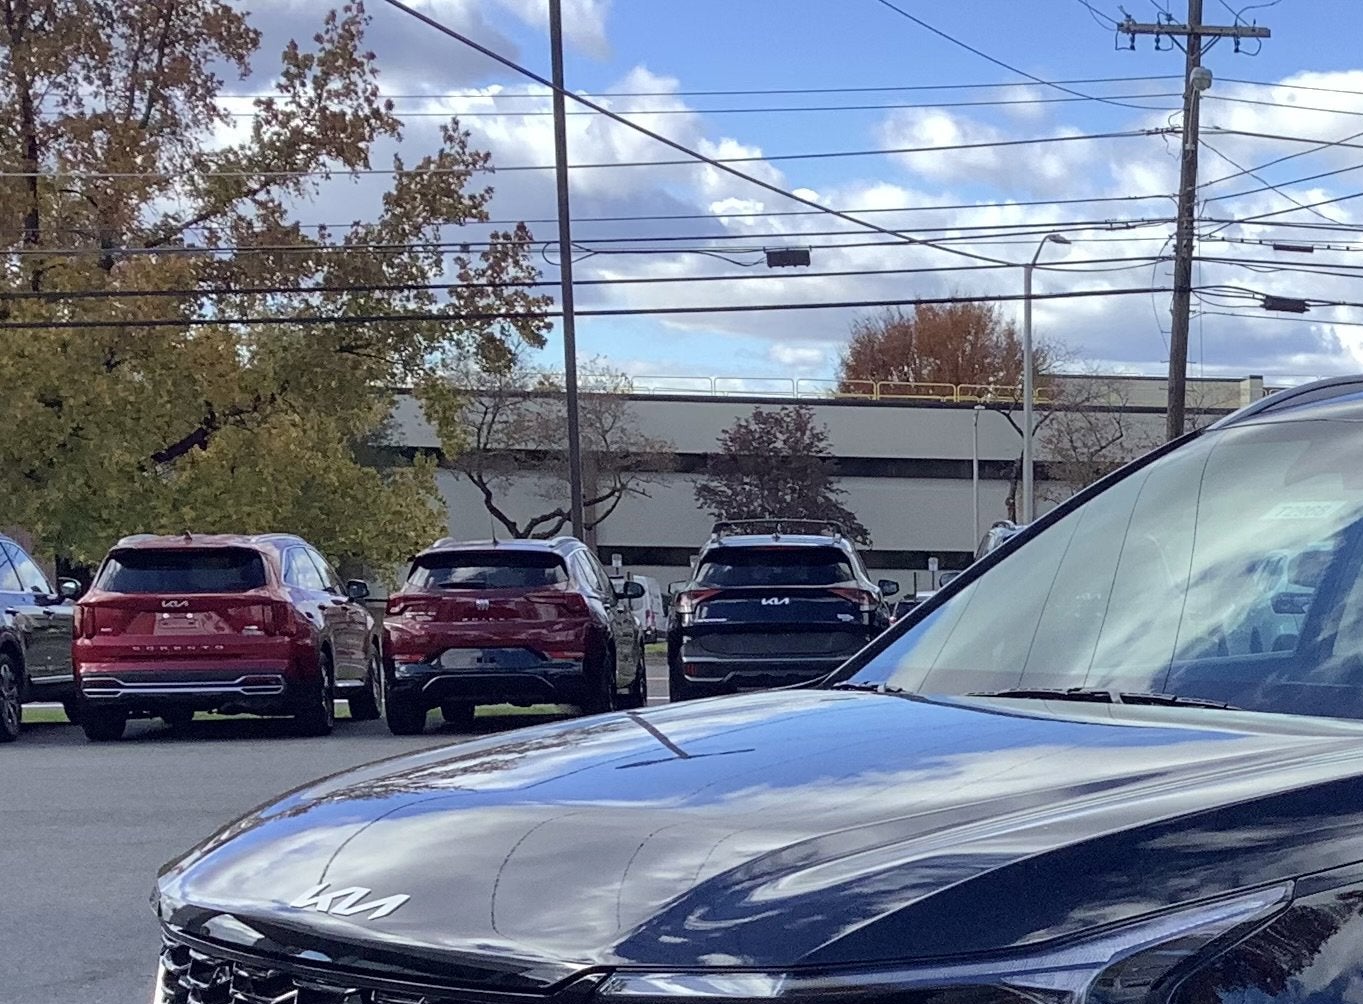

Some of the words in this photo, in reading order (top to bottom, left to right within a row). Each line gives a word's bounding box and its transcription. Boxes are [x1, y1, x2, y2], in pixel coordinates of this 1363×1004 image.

[161, 600, 189, 608] KIA
[761, 596, 790, 605] KIA
[290, 883, 411, 921] KIA
